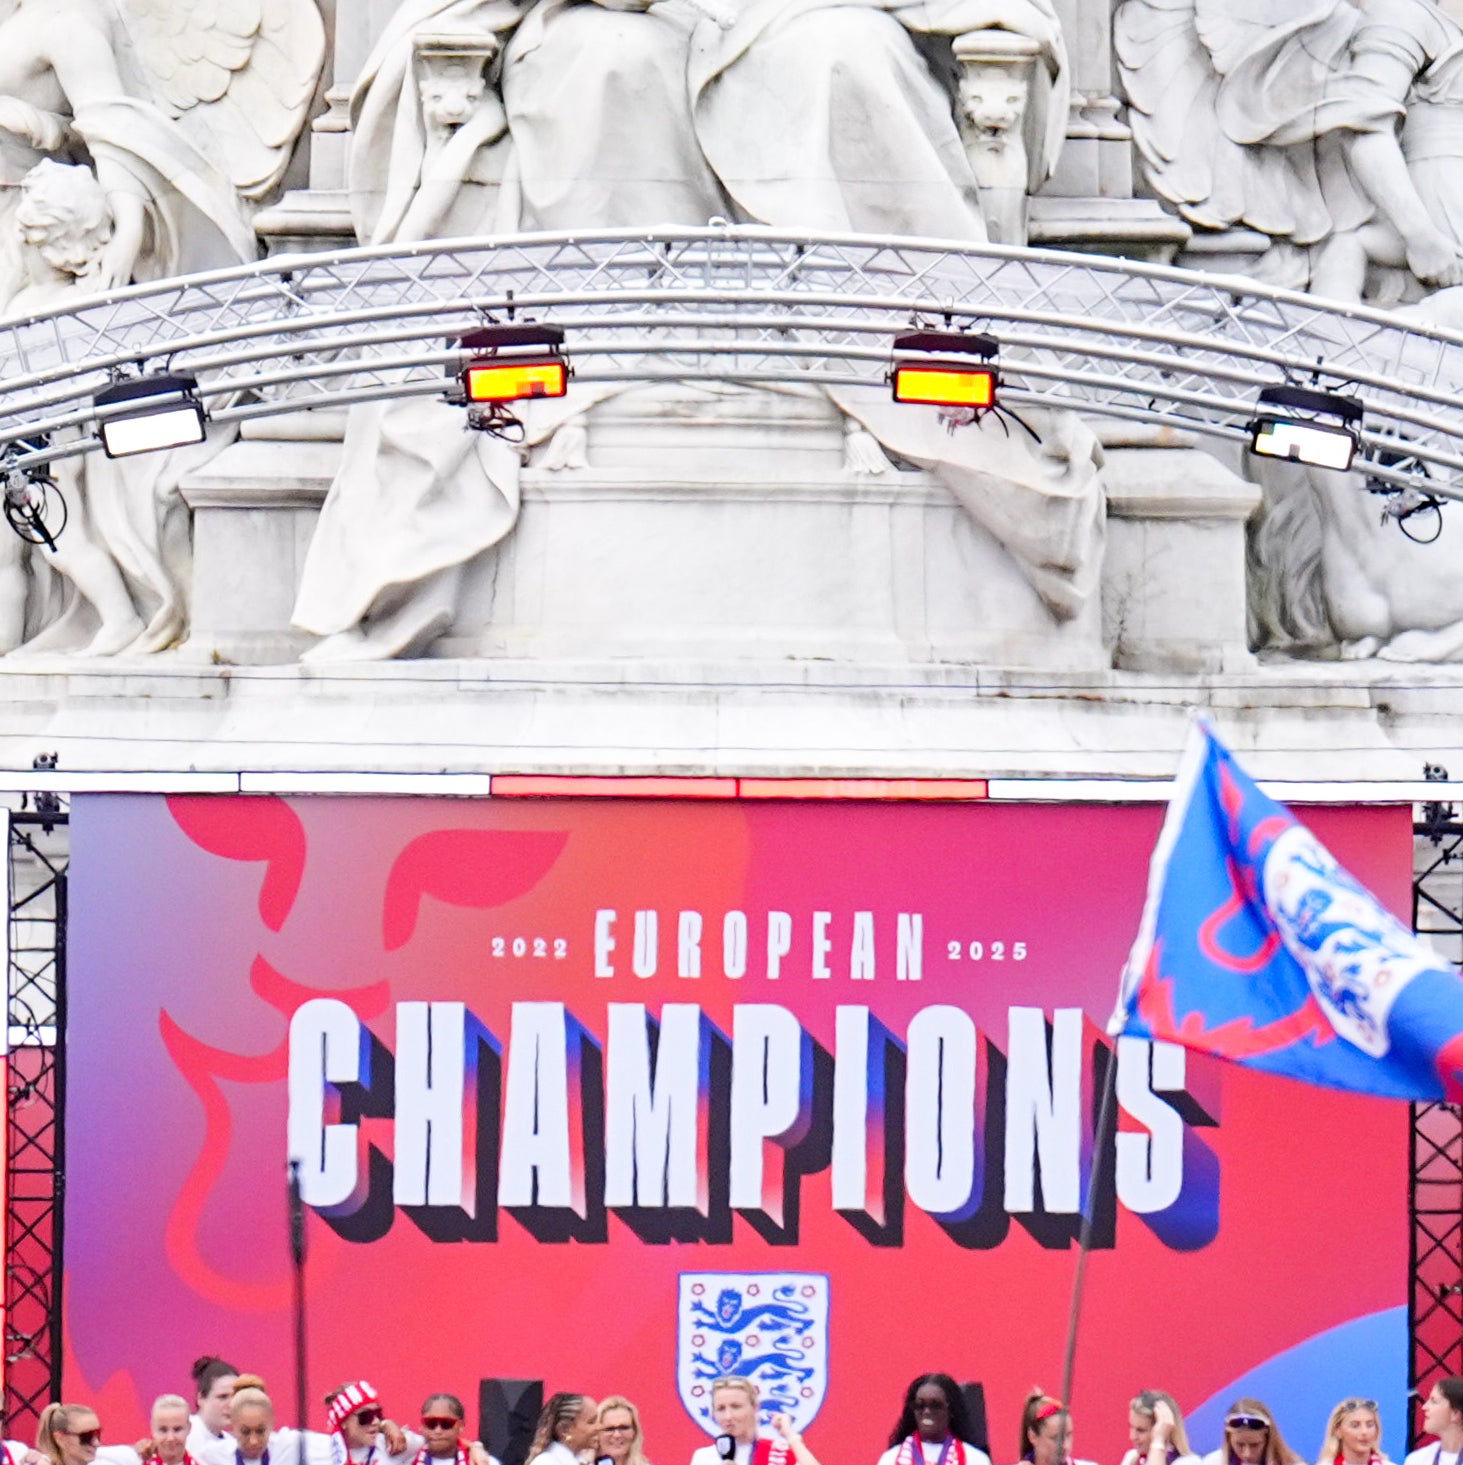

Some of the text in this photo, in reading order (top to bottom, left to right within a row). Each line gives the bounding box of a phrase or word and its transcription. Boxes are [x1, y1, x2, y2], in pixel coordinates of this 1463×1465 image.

[491, 909, 1028, 981] 2022 EUROPEAN 2025
[288, 998, 1186, 1214] CHAMPIONS
